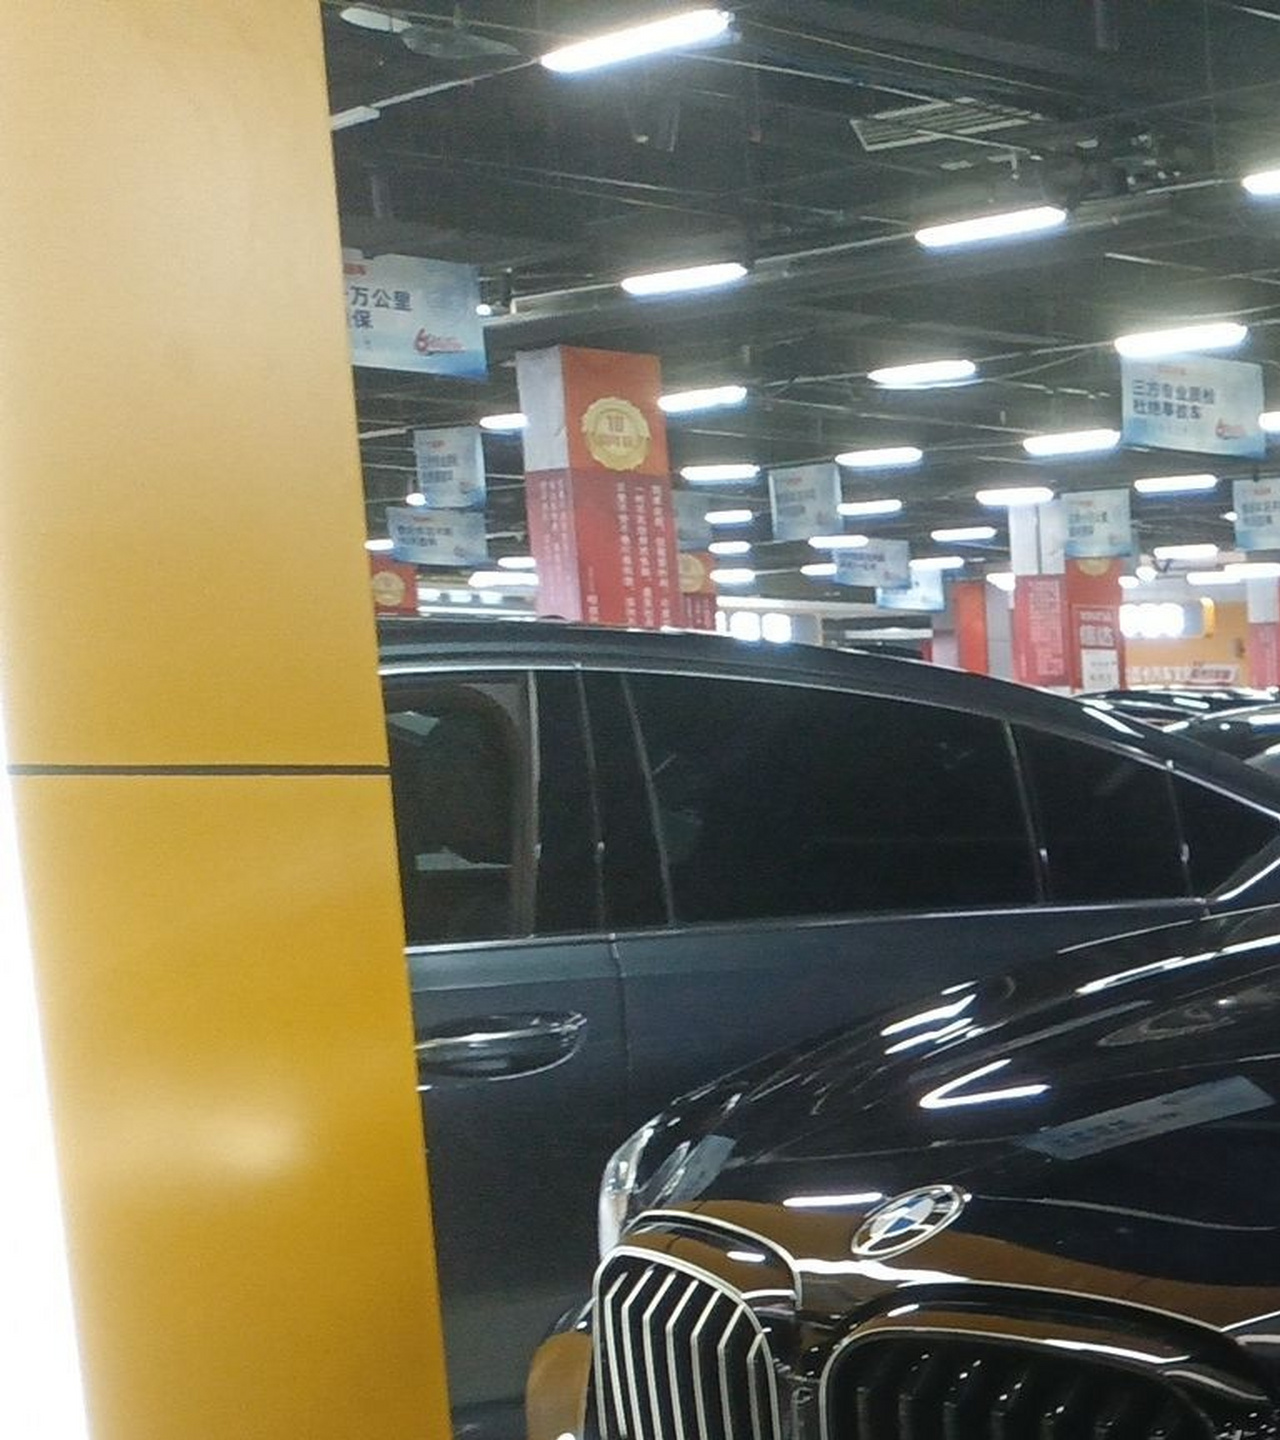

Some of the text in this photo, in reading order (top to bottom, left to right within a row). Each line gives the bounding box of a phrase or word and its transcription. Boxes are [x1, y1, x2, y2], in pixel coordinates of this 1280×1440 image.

[1133, 379, 1215, 405] 三方专业质检
[1133, 399, 1202, 420] 杜绝事故车
